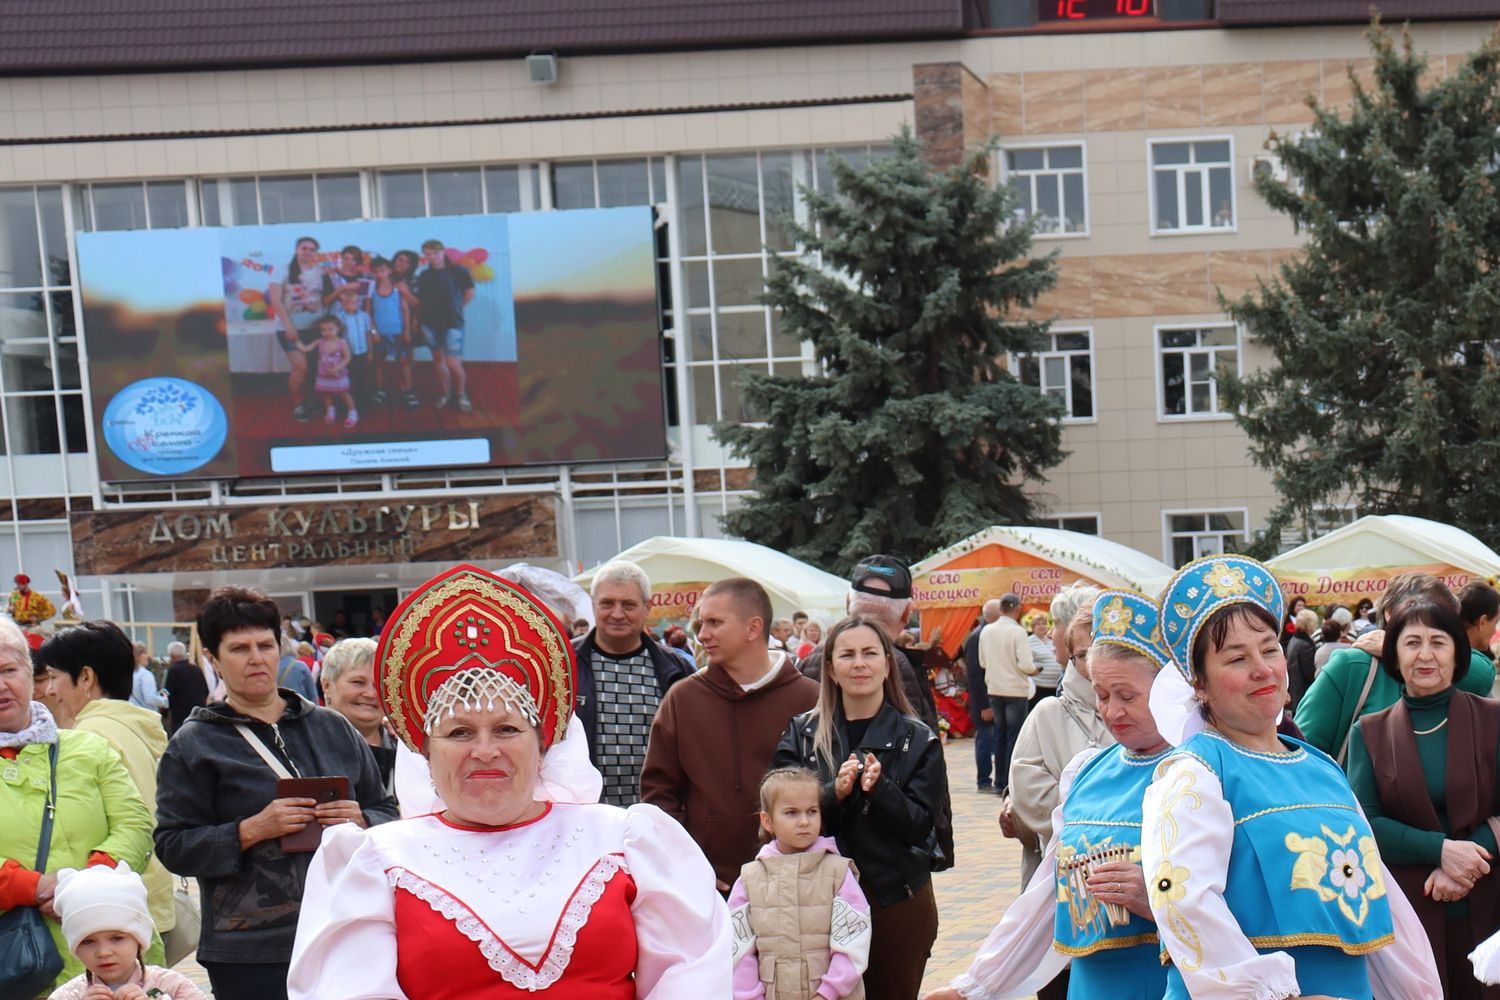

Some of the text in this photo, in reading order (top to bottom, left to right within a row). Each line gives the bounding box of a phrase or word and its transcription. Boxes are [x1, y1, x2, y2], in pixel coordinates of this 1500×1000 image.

[149, 501, 480, 544] ДОМ КУЛЬТУРЫ
[210, 530, 415, 563] ЦЕНТРАЛЬНЫЙ
[929, 573, 961, 585] село
[1030, 568, 1062, 580] село
[1012, 580, 1061, 600] Орехов
[1281, 581, 1309, 595] ело
[1316, 575, 1388, 595] Донска
[651, 591, 697, 614] агод
